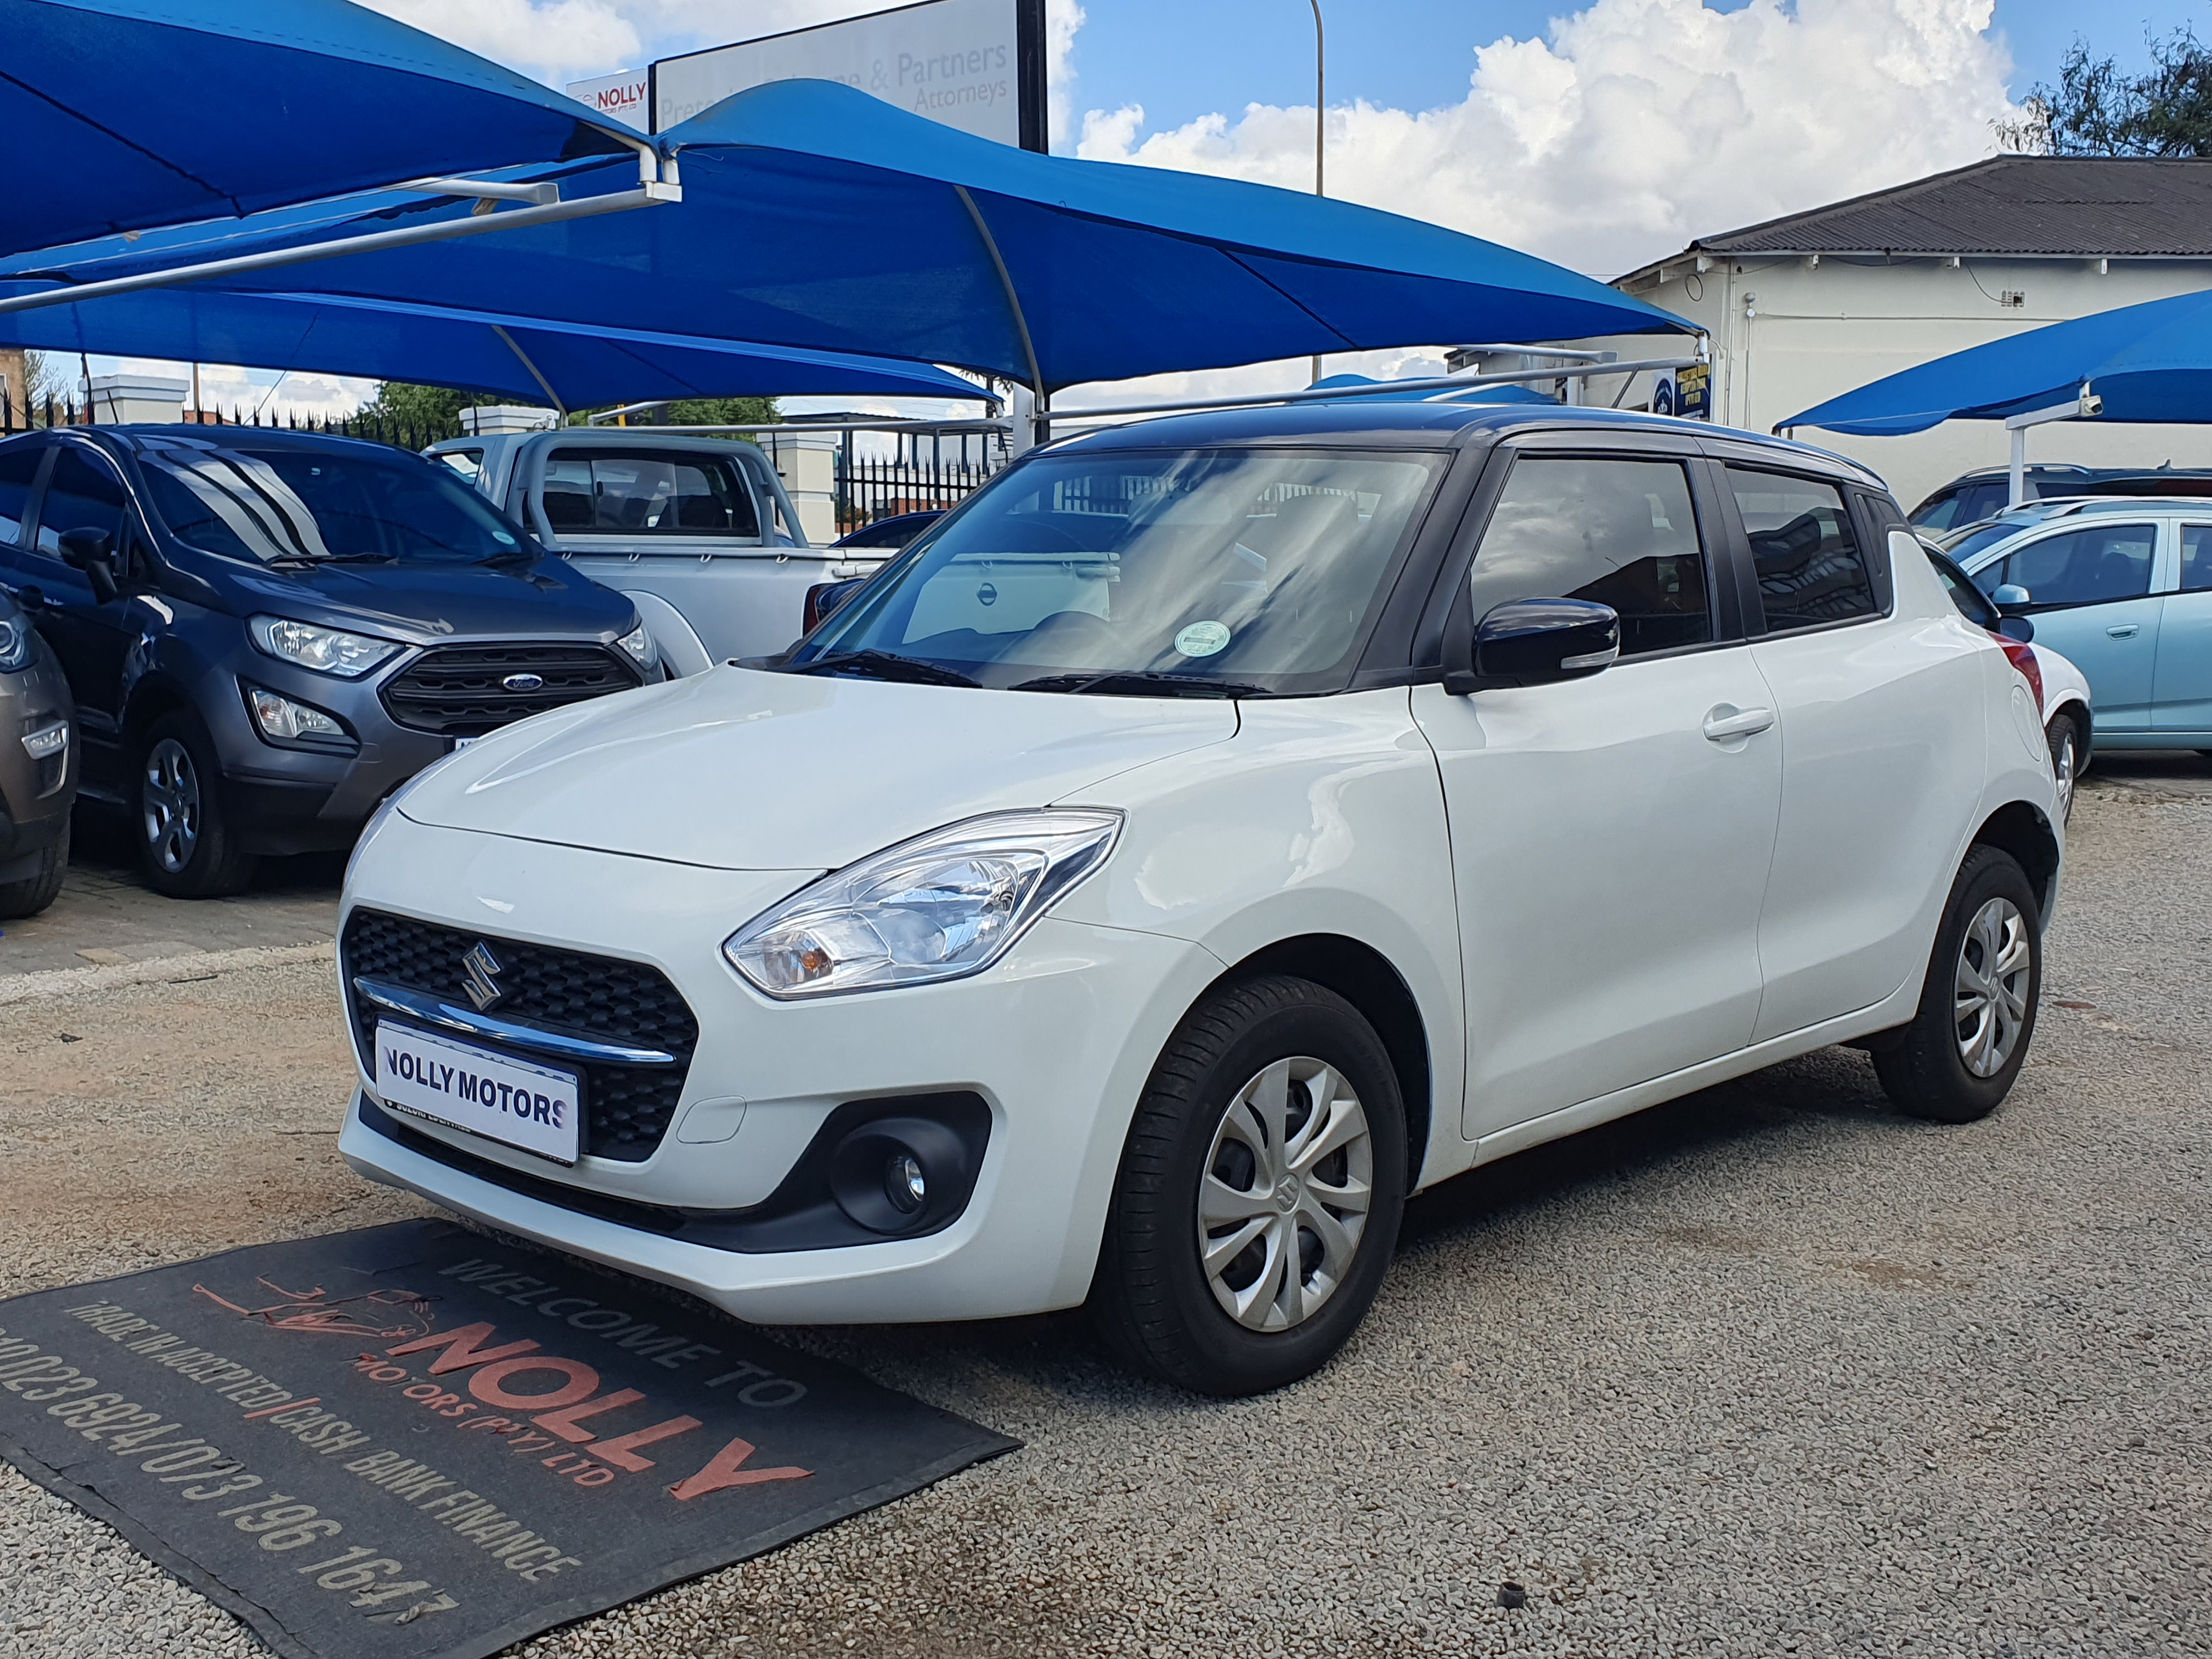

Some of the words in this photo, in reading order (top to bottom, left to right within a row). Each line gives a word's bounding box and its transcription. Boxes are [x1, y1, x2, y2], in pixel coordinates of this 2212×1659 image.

[598, 82, 646, 109] NOLLY
[871, 60, 888, 91] &
[898, 45, 1006, 86] Partners
[915, 80, 1007, 112] Attorneys
[513, 678, 535, 687] Ford
[384, 1046, 455, 1093] NOLLY
[459, 1070, 568, 1130] MOTORS
[438, 1258, 722, 1368] WELCOME
[704, 1360, 808, 1407] TO
[63, 1300, 160, 1342] TRADE
[126, 1332, 186, 1355] IN
[343, 1450, 458, 1501] BANK
[417, 1489, 583, 1582] FINANCE
[353, 1352, 478, 1417] MOORS
[541, 1452, 615, 1486] LTD
[385, 1321, 816, 1502] NOLLY
[217, 1492, 342, 1551] 196
[297, 1545, 461, 1626] 1647
